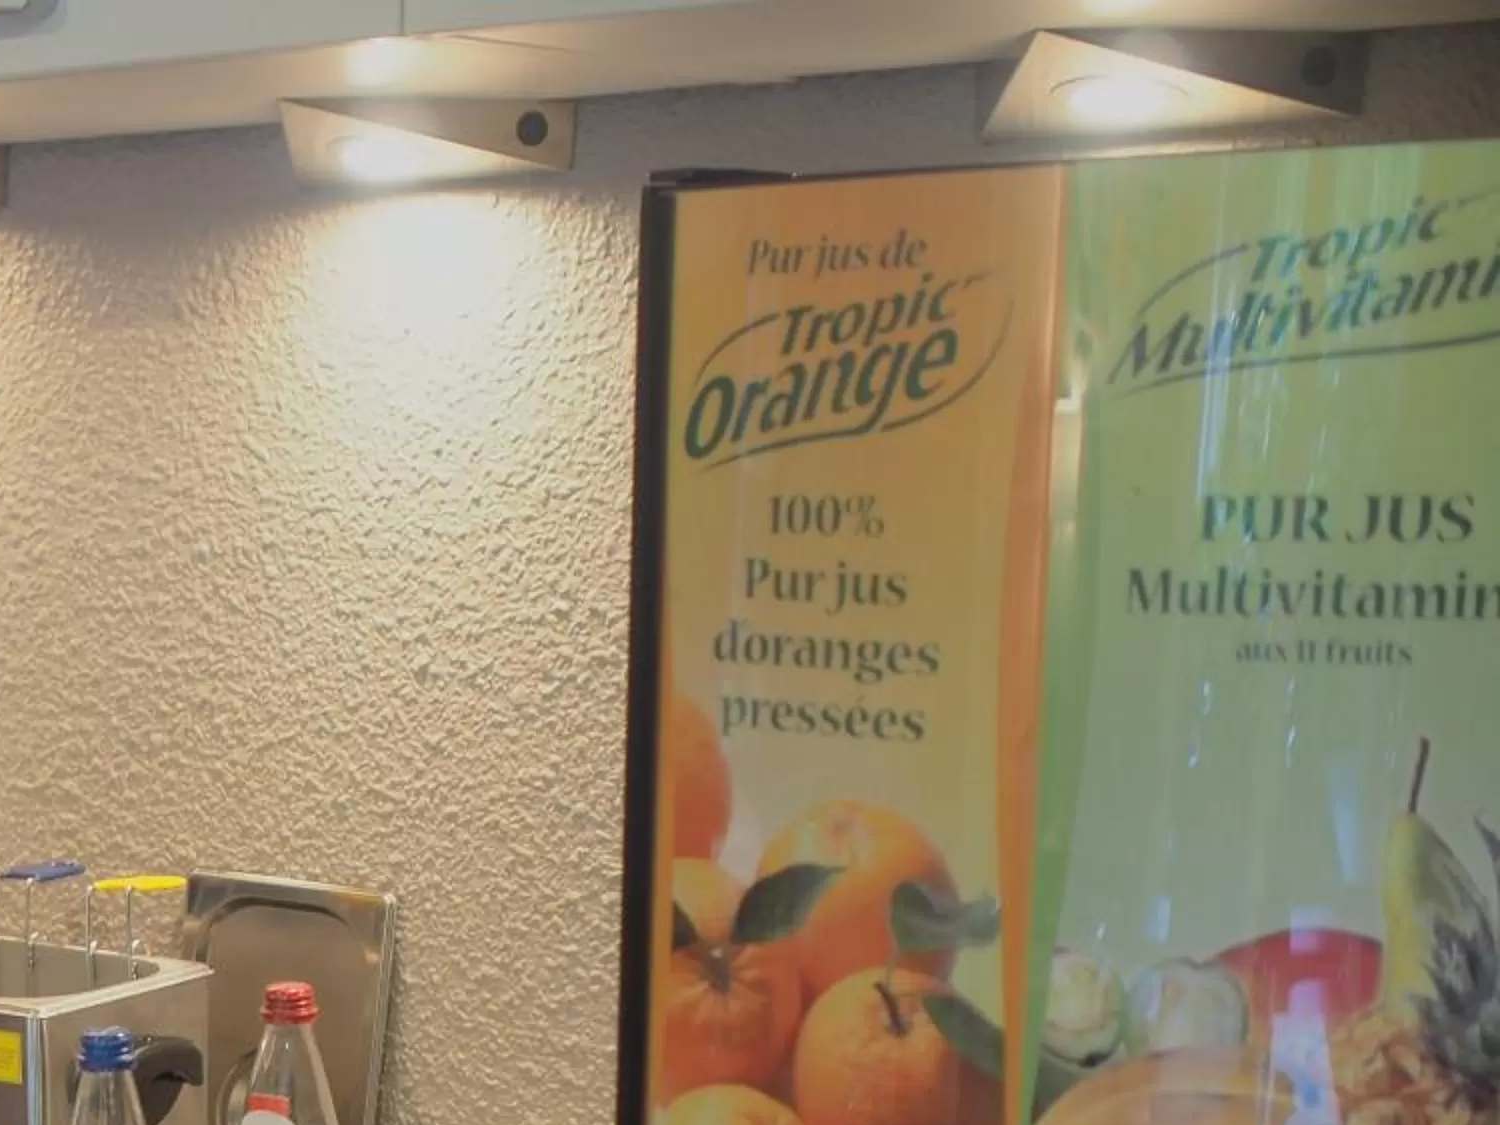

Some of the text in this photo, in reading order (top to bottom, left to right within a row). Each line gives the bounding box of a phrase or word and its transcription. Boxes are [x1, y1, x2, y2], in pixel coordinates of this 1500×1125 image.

[748, 228, 929, 279] Pur jus de
[1244, 195, 1448, 282] Tropic
[779, 272, 960, 356] Tropic
[684, 328, 960, 462] Orange
[769, 493, 886, 539] 100%
[1202, 492, 1476, 545] PUR JUS
[744, 557, 910, 616] Pur jus
[1326, 639, 1413, 666] fruits
[720, 694, 927, 742] pressées
